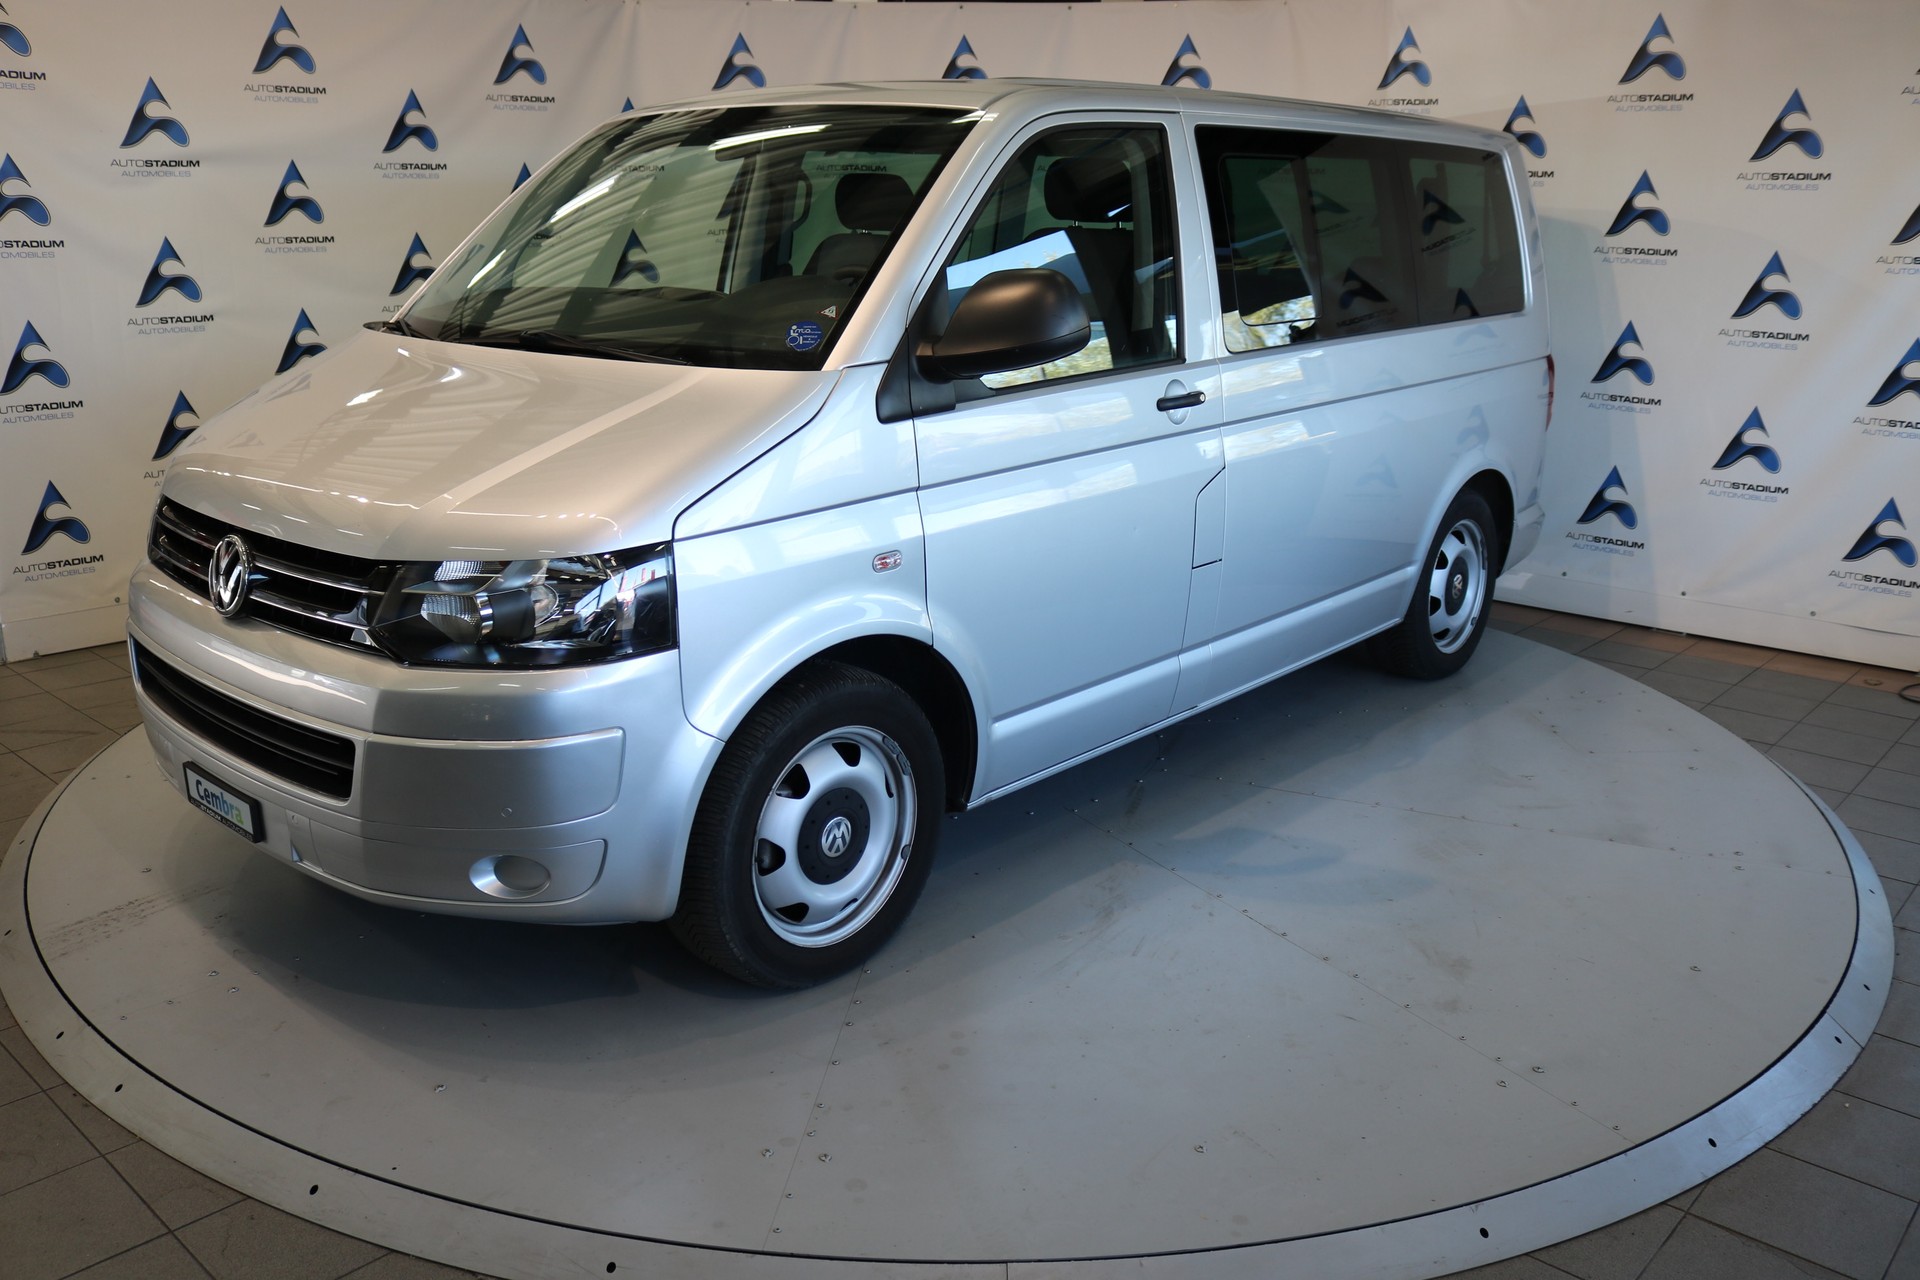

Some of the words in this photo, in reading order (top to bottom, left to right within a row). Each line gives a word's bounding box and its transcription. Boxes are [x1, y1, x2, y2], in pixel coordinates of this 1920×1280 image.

[243, 83, 327, 95] AUTOSTADIUM
[254, 94, 319, 104] AUTOMOBILES
[485, 94, 556, 104] AUTOSTADIUM
[1368, 98, 1439, 107] AUTOSTADIUM
[1607, 93, 1694, 104] AUTOSTADIUM
[493, 104, 548, 112] AUTOMOBILES
[1615, 104, 1683, 113] AUTOMOBILES
[110, 159, 201, 168] AUTOSTADIUM
[373, 162, 448, 171] AUTOSTADIUM
[121, 170, 192, 178] AUTOMOBILES
[382, 172, 440, 180] AUTOMOBILES
[1736, 172, 1832, 182] AUTOSTADIUM
[1745, 183, 1820, 192] AUTOMOBILES
[255, 236, 336, 245] AUTOSTADIUM
[264, 246, 328, 254] AUTOMOBILES
[1594, 246, 1679, 257] AUTOSTADIUM
[1602, 256, 1668, 266] AUTOMOBILES
[127, 314, 214, 327] AUTOSTADIUM
[137, 325, 206, 335] AUTOMOBILES
[1718, 328, 1810, 342] AUTOSTADIUM
[1727, 340, 1798, 351] AUTOMOBILES
[1580, 391, 1662, 406] AUTOSTADIUM
[1588, 402, 1652, 414] AUTOMOBILES
[2, 411, 75, 424] AUTOMOBILES
[1700, 478, 1789, 495] AUTOSTADIUM
[1708, 489, 1778, 503] AUTOMOBILES
[1565, 531, 1645, 550] AUTOSTADIUM
[1572, 542, 1635, 557] AUTOMOBILES
[13, 554, 104, 575] AUTOSTADIUM
[24, 566, 96, 583] AUTOMOBILES
[1837, 581, 1912, 598] AUTOMOBILES
[195, 779, 244, 825] Cembra
